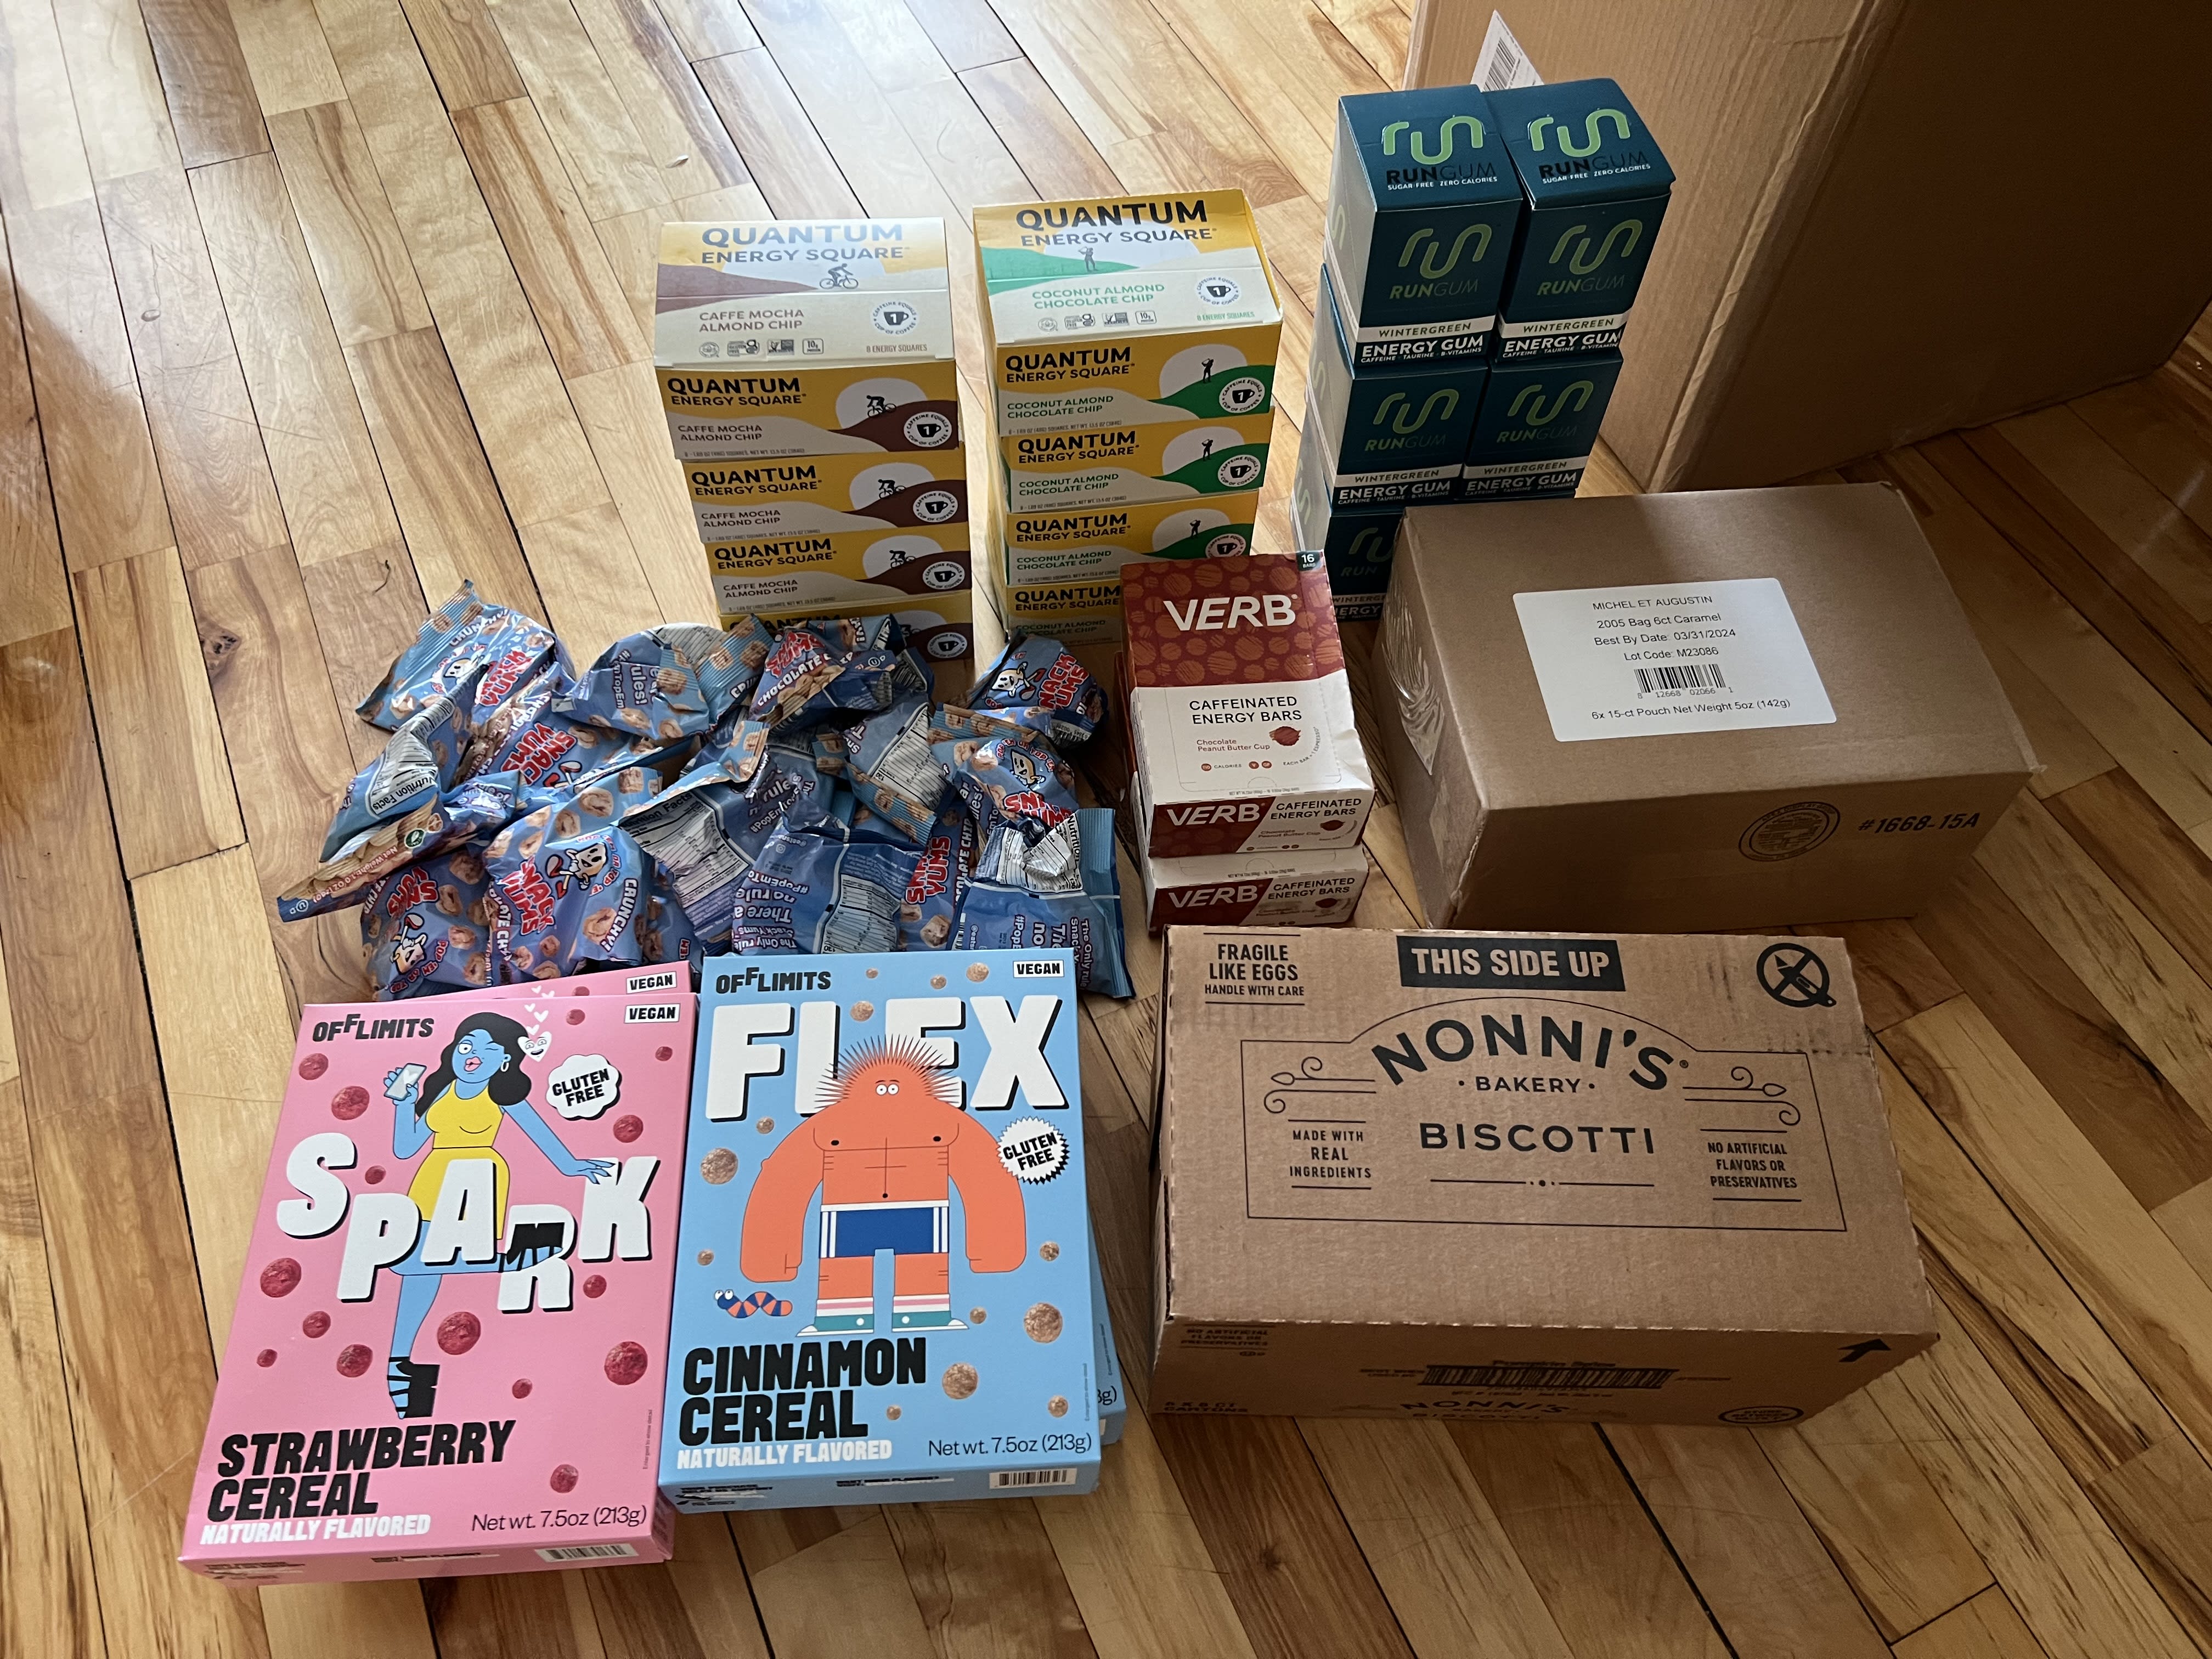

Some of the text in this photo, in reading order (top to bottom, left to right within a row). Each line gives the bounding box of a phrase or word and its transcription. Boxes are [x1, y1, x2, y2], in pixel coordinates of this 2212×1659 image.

[1462, 176, 1498, 184] CALORIES
[1016, 200, 1207, 231] QUANTUM
[702, 223, 902, 248] QUANTUM
[1021, 233, 1113, 247] ENERGY
[701, 249, 798, 264] ENERGY
[1032, 284, 1165, 300] COCONUT ALMOND
[1034, 294, 1154, 309] CHOCOLATE CHIP
[699, 309, 804, 321] CAFFE MOCHA
[1227, 311, 1255, 319] SQUARES
[699, 320, 802, 332] ALMOND CHIP
[1379, 322, 1471, 338] WINTERGREEN
[1523, 318, 1614, 333] WINTERGREEN
[899, 344, 927, 352] SQUARES
[1362, 335, 1483, 357] ENERGY GUM
[1505, 330, 1621, 353] ENERGY GUM
[1006, 347, 1131, 372] QUANTUM
[1361, 353, 1396, 362] CAFFEINE
[1402, 351, 1434, 359] TAURINE
[1007, 371, 1066, 383] ENERGY
[668, 378, 800, 394] QUANTUM
[672, 396, 734, 406] ENERGY
[1007, 396, 1114, 410] COCONUT ALMOND
[1008, 405, 1102, 419] CHOCOLATE CHIP
[680, 433, 732, 442] ALMOND
[1355, 470, 1440, 483] WINTERGREEN
[1339, 481, 1451, 499] ENERGY GUM
[1301, 554, 1314, 563] 16
[1593, 601, 1636, 610] MICHEL
[1656, 596, 1713, 607] AUGUSTIN
[1163, 595, 1296, 631] VERB
[1598, 613, 1722, 630] 2005 Bag 6ct Caramel
[1594, 636, 1620, 646] Best
[1623, 635, 1638, 645] By
[1674, 629, 1736, 641] 03/31/2024
[1624, 652, 1640, 661] Lot
[1677, 647, 1719, 657] M23086
[1189, 696, 1297, 710] CAFFEINATED
[1592, 699, 1791, 720] 6x 15-ct Pouch Net Weight 5oz (142g)
[1193, 710, 1302, 724] ENERGY BARS
[1254, 743, 1270, 752] Cup
[1276, 798, 1362, 811] CAFFEINATED
[1167, 804, 1260, 826] VERB
[1271, 808, 1356, 820] ENERGY BARS
[1858, 812, 1980, 834] #1668-15A
[925, 836, 951, 896] YUMS
[601, 878, 637, 952] CRUNCHY!
[1218, 944, 1288, 962] FRAGILE
[1017, 963, 1060, 975] VEGAN
[1412, 949, 1610, 977] THIS SIDE UP
[1210, 964, 1299, 981] LIKE EGGS
[629, 975, 674, 991] VEGAN
[1205, 984, 1305, 996] HANDLE WITH CARE
[629, 1007, 676, 1020] VEGAN
[552, 1069, 610, 1097] GLUTEN
[566, 1084, 605, 1107] FREE
[1293, 1130, 1363, 1142] MADE WITH
[1420, 1122, 1654, 1154] BISCOTTI
[1003, 1132, 1057, 1161] GLUTEN
[1311, 1147, 1348, 1160] REAL
[1708, 1142, 1787, 1155] NO ARTIFICIAL
[1018, 1148, 1055, 1171] FREE
[1717, 1159, 1786, 1171] FLAVORS OR
[1290, 1166, 1372, 1178] INGREDIENTS
[1710, 1176, 1797, 1189] PRESERVATIVES
[683, 1338, 926, 1396] CINNAMON
[678, 1390, 869, 1447] CEREAL
[218, 1420, 516, 1478] STRAWBERRY
[929, 1433, 1092, 1457] Net wt. 7.5oz (213g)
[677, 1439, 893, 1470] NATURALLY FLAVORED
[207, 1473, 379, 1523] CEREAL
[472, 1505, 648, 1532] Net wt. 7.5oz (213g)
[200, 1515, 431, 1545] NATURALLY FLAVORED
